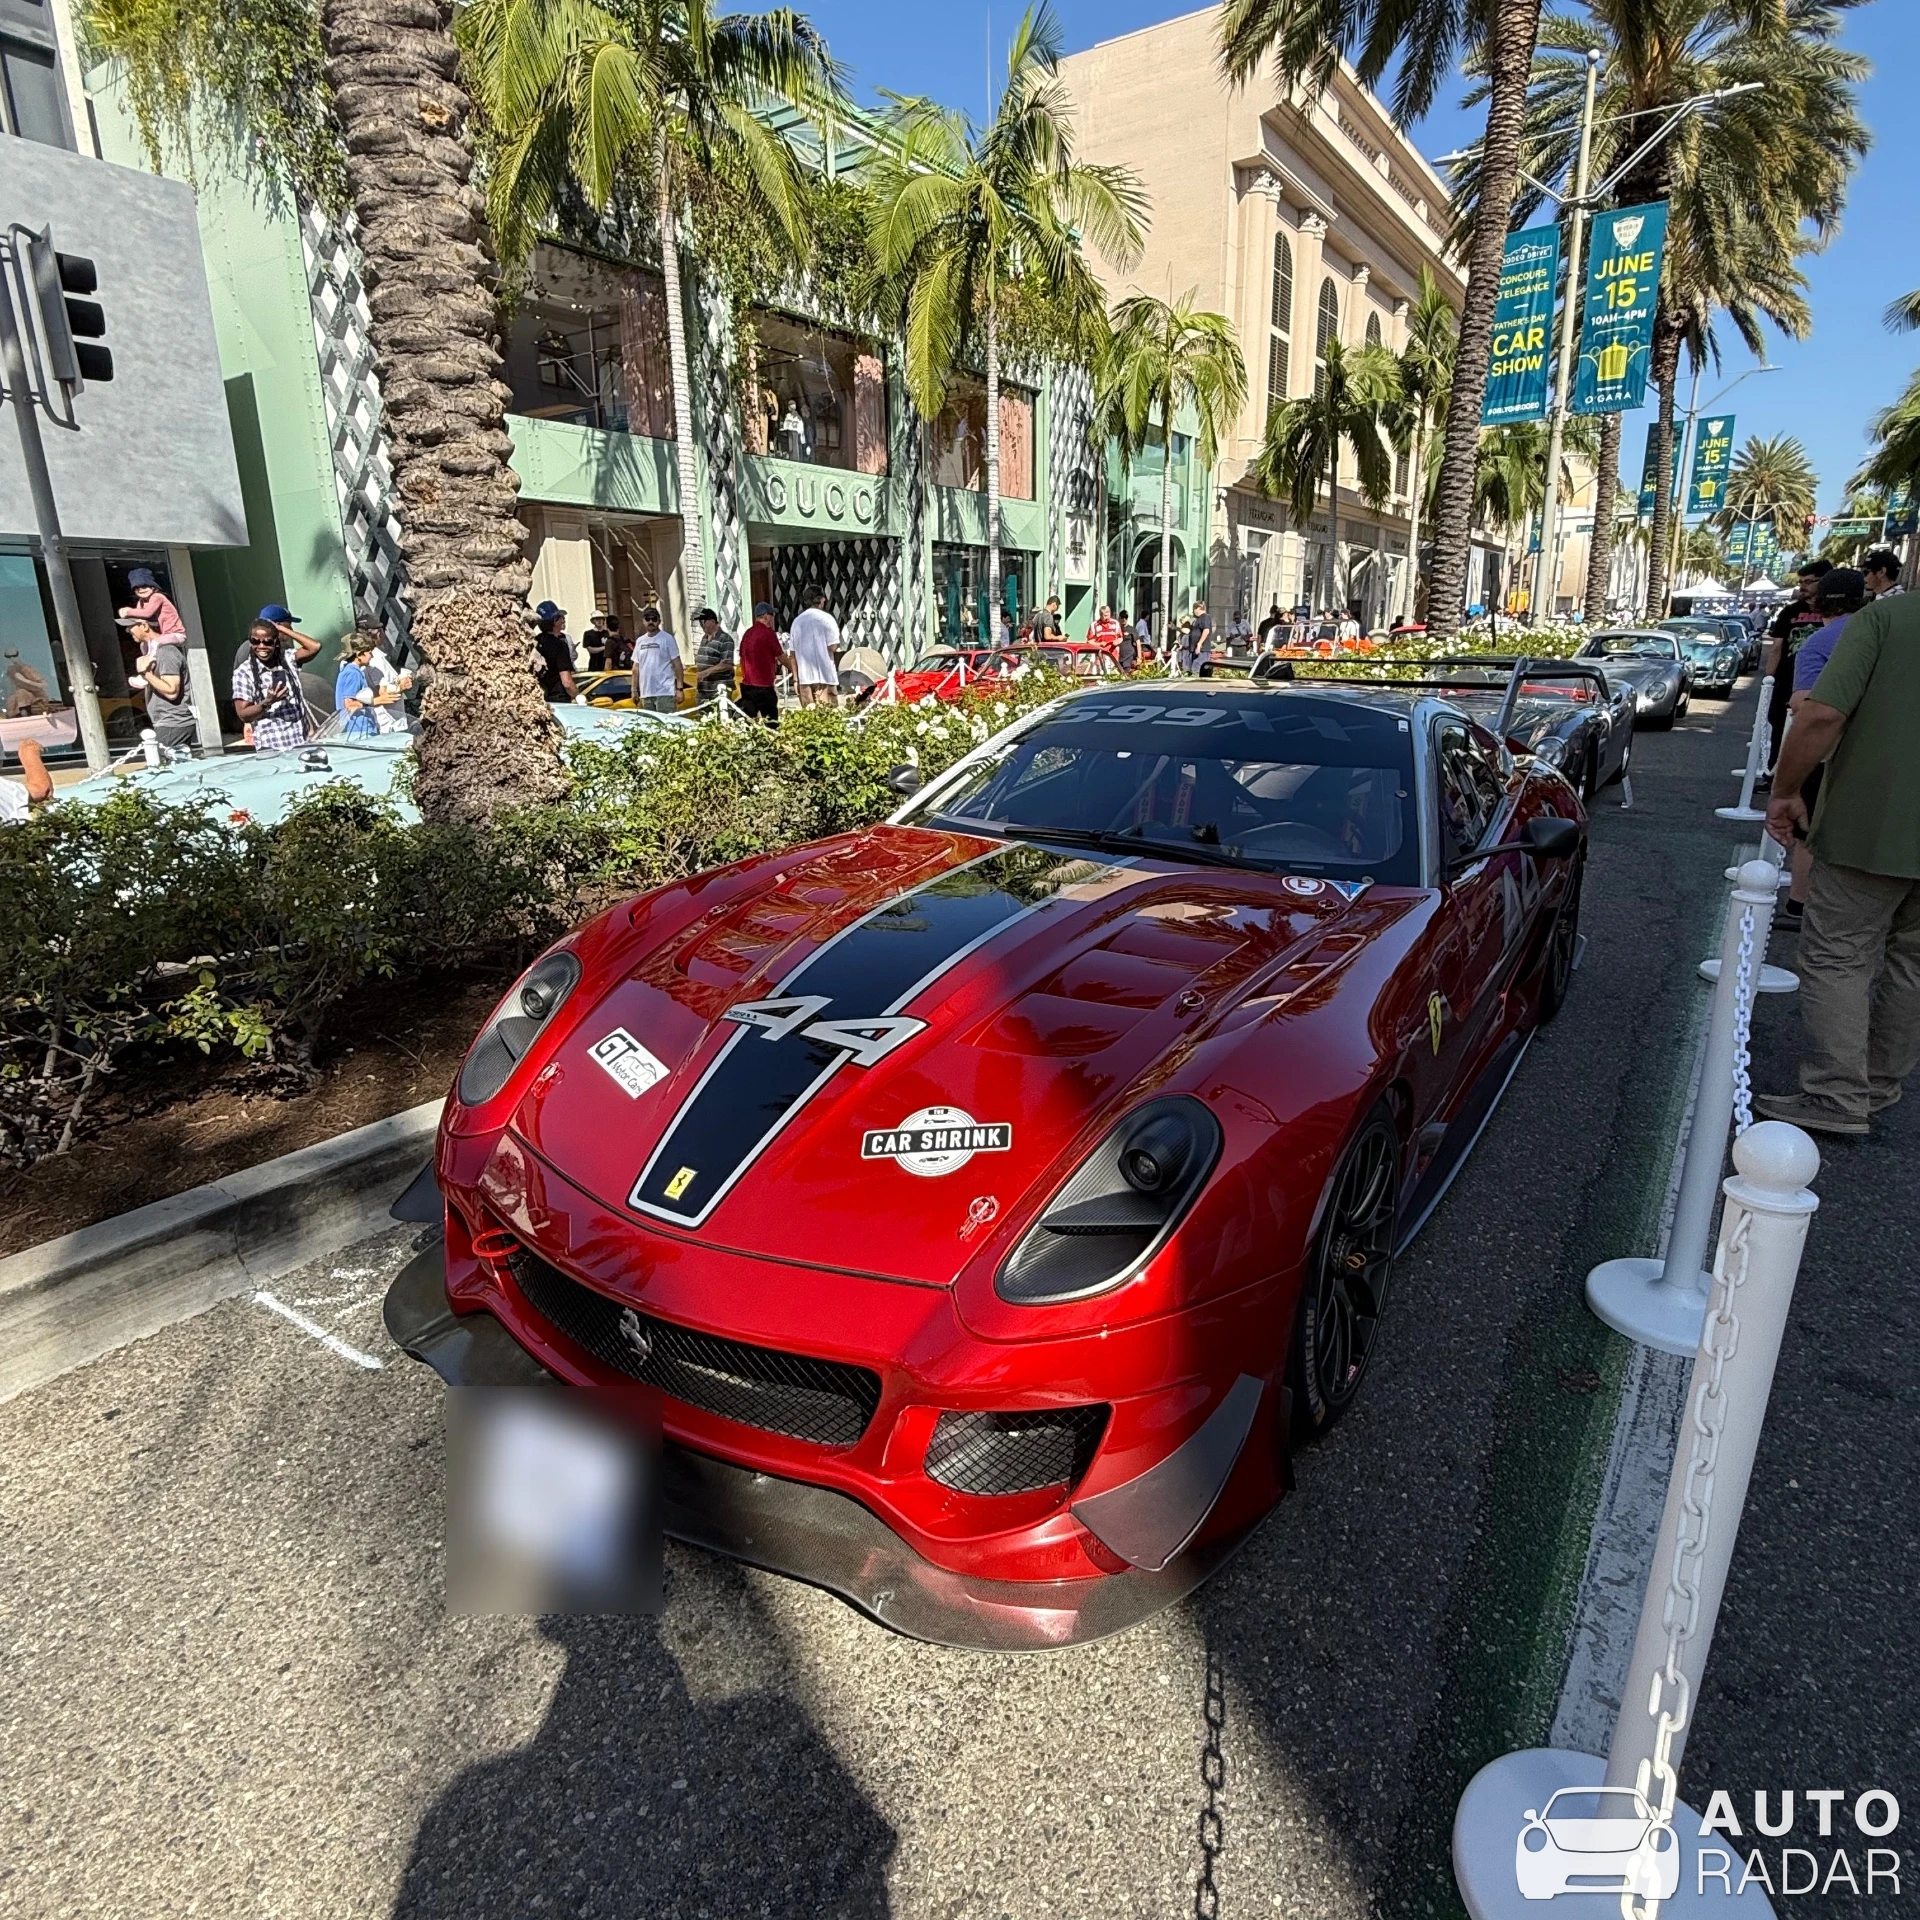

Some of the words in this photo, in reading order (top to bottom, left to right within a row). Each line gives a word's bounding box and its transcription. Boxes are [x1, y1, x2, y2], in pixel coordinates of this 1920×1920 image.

[1500, 268, 1548, 286] CONCOURS
[1594, 251, 1655, 280] JUNE
[1494, 317, 1529, 331] FATHER'S
[1530, 313, 1547, 323] DAY
[1492, 327, 1545, 357] CAR
[1491, 354, 1544, 377] SHOW
[1585, 392, 1632, 405] O'GARA
[1698, 437, 1730, 450] JUNE
[766, 473, 887, 524] GUCCI
[1047, 704, 1375, 742] 599XX
[1297, 879, 1310, 889] E
[719, 994, 928, 1067] 44
[595, 1033, 640, 1066] GT
[612, 1061, 631, 1081] Motor
[627, 1077, 643, 1095] Cars
[871, 1133, 912, 1153] CAR
[920, 1128, 1001, 1149] SHRINK
[1305, 1308, 1319, 1406] MICHELIN
